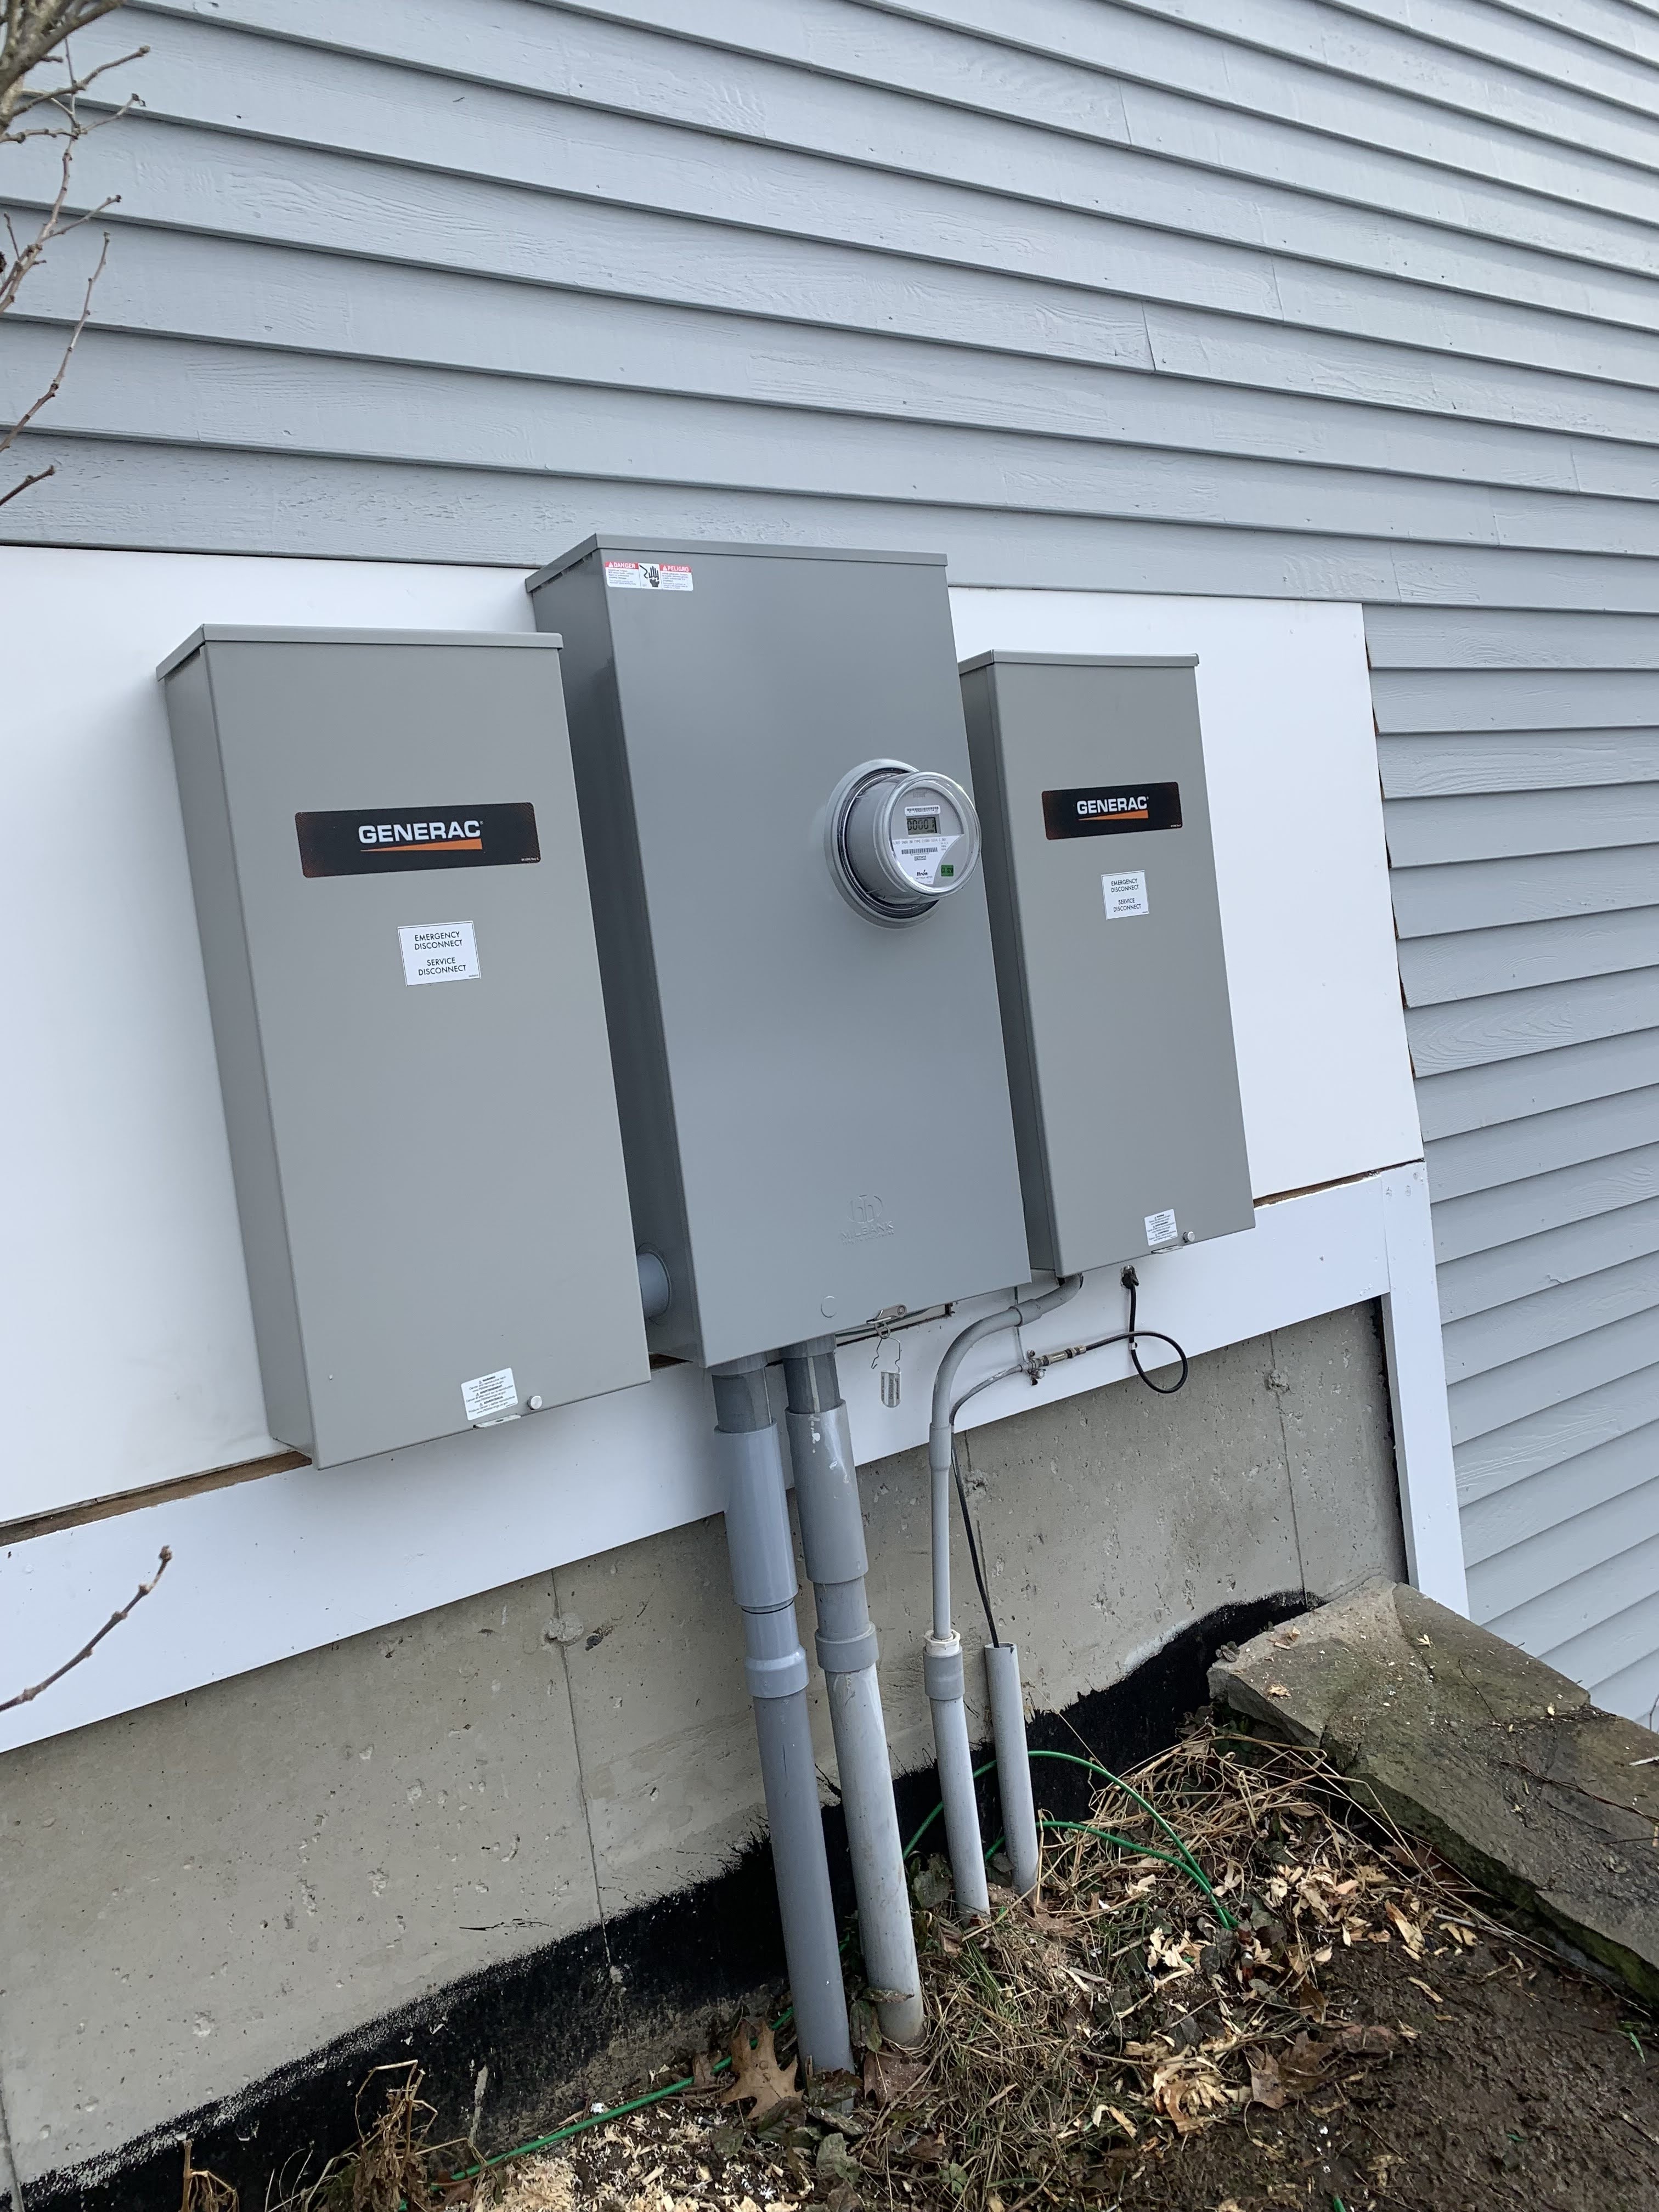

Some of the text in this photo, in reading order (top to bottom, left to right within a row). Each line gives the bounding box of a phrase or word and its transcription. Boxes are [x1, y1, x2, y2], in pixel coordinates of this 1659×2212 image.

[1077, 796, 1147, 815] GENERAC
[358, 820, 481, 844] GENERAC
[1111, 878, 1137, 886] EMERGENCY
[1111, 884, 1139, 893] DISCONNECT
[1113, 904, 1141, 912] DISCONNECT
[415, 931, 460, 941] EMERGENCY
[414, 939, 462, 950] DISCONNECT
[427, 957, 456, 966] SERVICE
[418, 964, 466, 975] DISCONNECT
